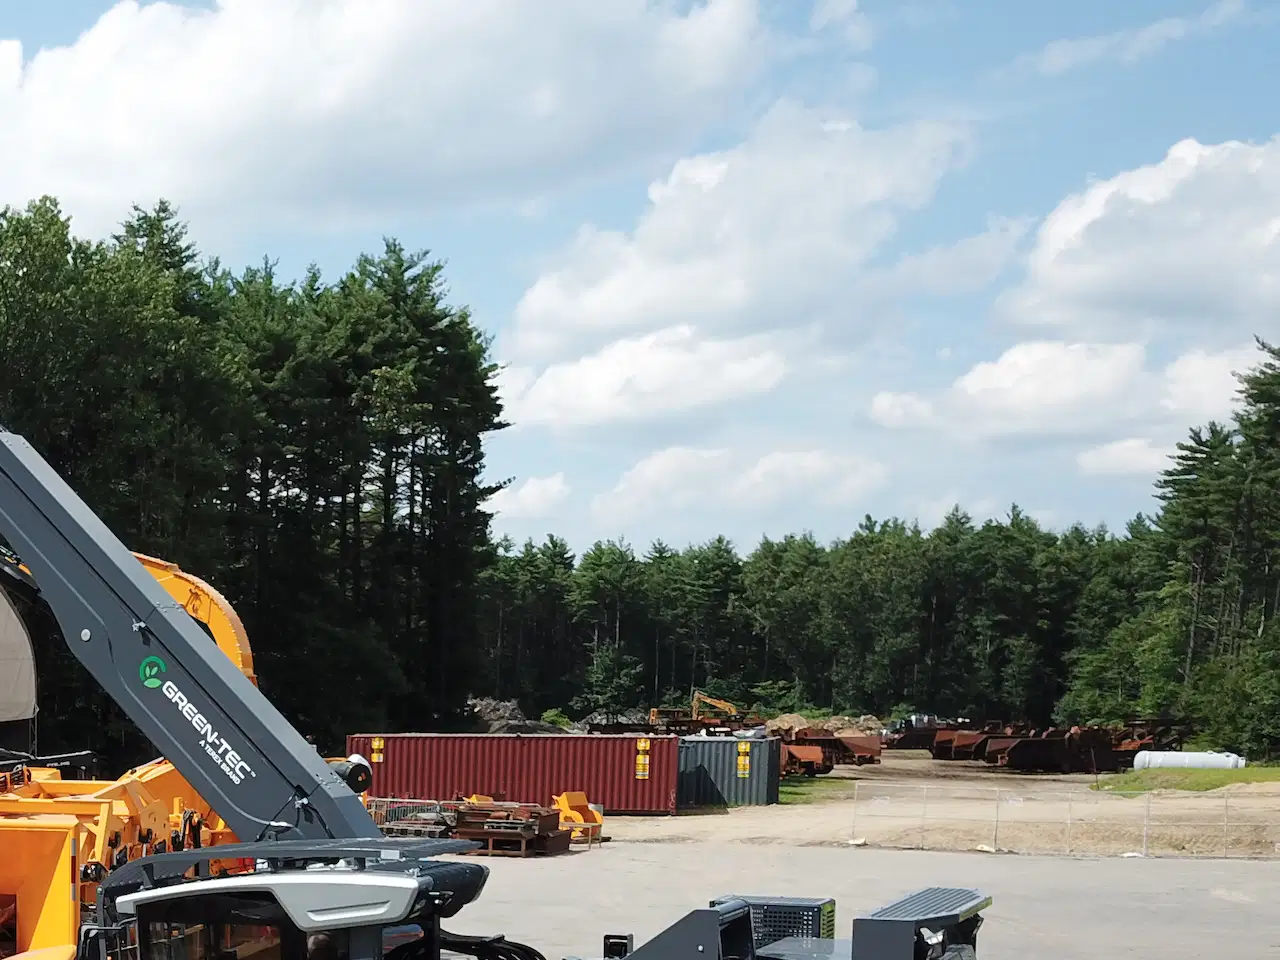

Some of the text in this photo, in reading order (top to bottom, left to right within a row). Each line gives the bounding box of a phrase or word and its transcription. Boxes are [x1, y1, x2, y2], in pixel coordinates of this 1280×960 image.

[162, 680, 251, 779] GREEN-TEC
[205, 744, 223, 765] TEREX
[220, 762, 241, 785] BRAND
